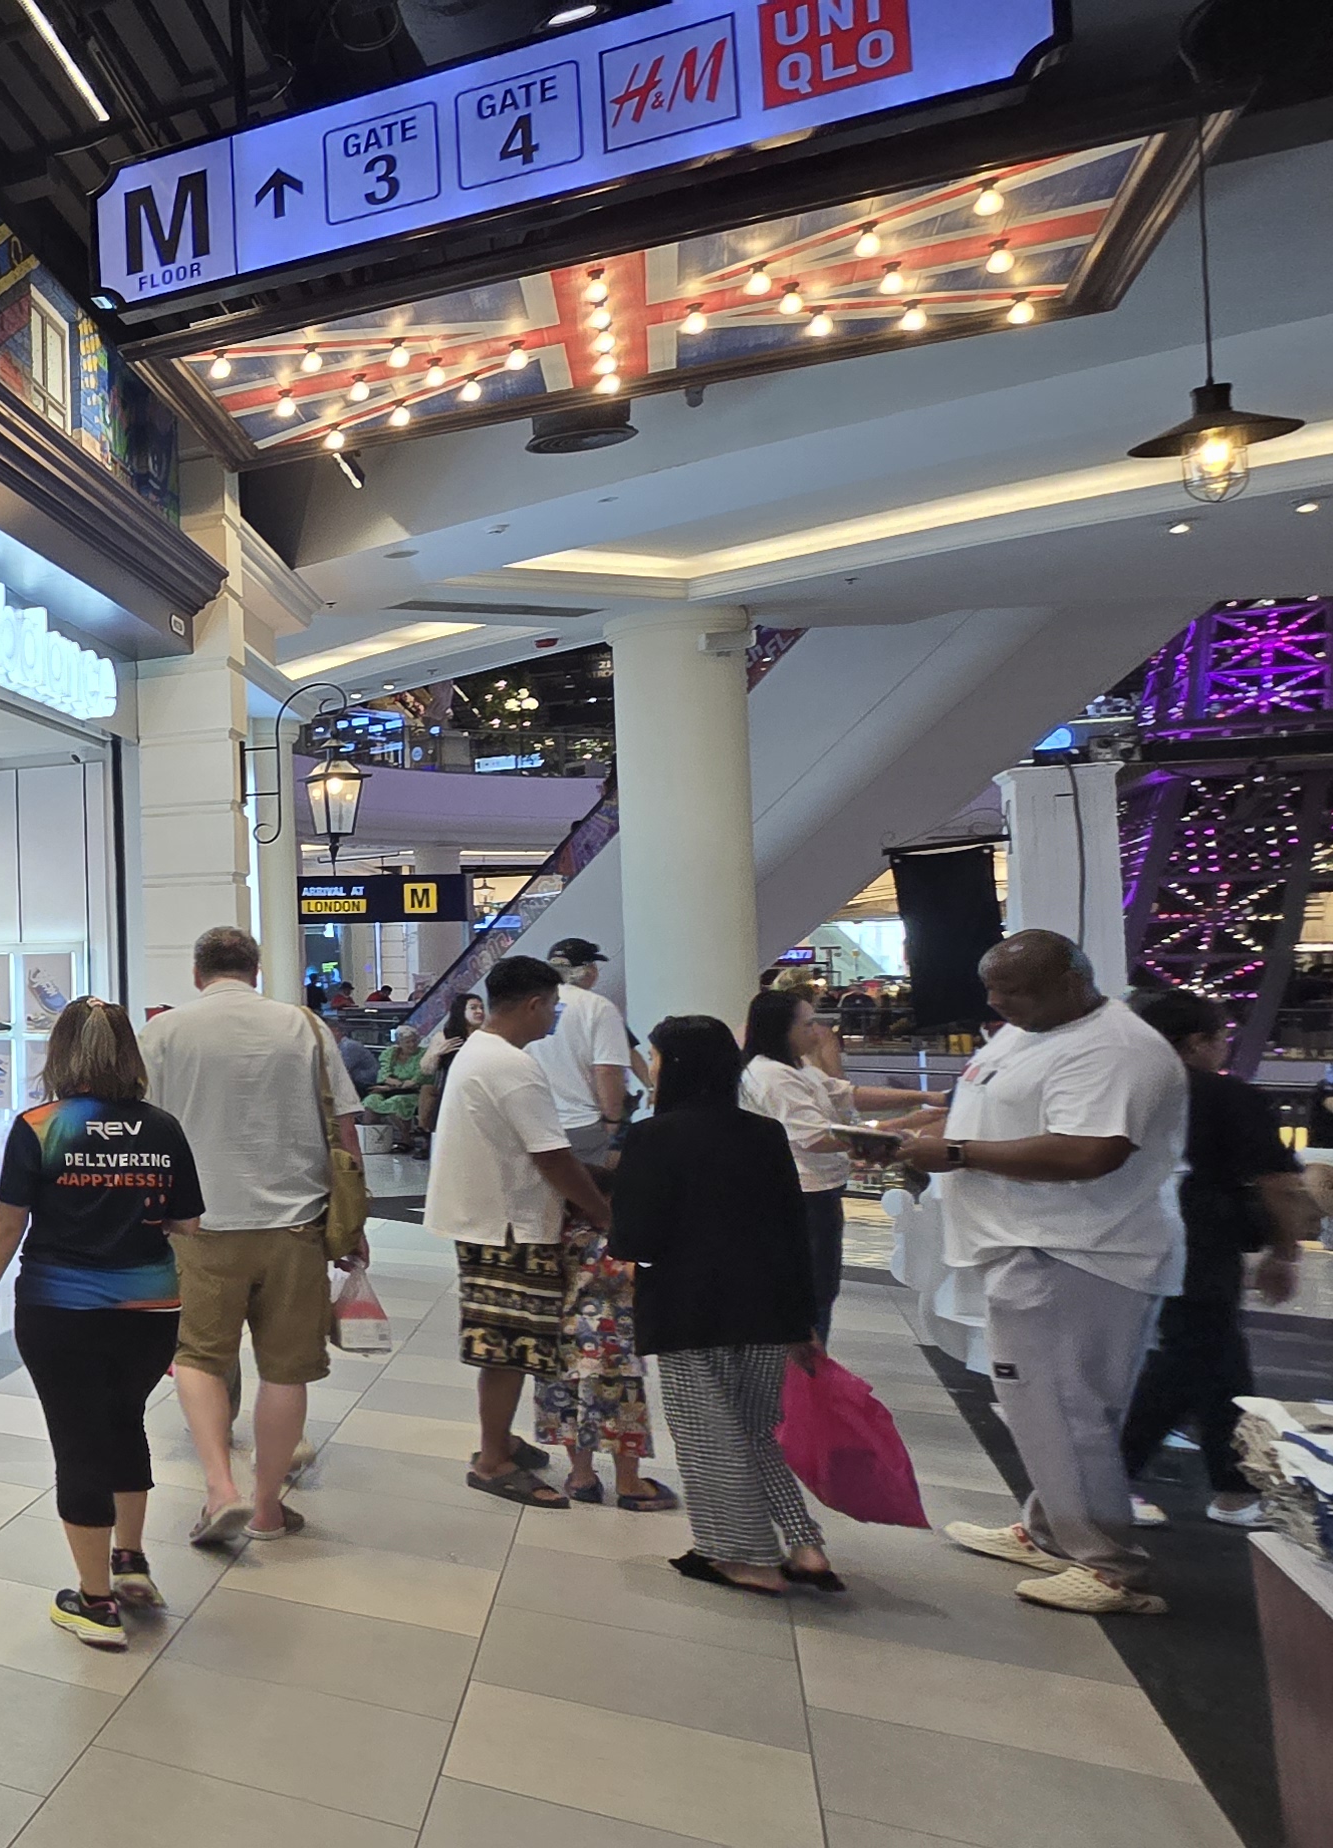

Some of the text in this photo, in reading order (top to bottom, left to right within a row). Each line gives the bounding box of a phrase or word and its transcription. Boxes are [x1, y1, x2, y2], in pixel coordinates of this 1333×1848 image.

[774, 0, 881, 46] UNI
[609, 37, 727, 129] H&M
[777, 29, 895, 94] QLO
[475, 75, 558, 119] GATE
[343, 115, 417, 158] GATE
[499, 112, 539, 166] 4
[363, 153, 400, 206] 3
[124, 168, 210, 277] M
[138, 262, 201, 292] FLOOR
[307, 900, 361, 913] LONDON
[410, 888, 431, 909] M
[56, 1172, 173, 1188] HAPPINESS!!
[64, 1152, 171, 1168] DELIVERING
